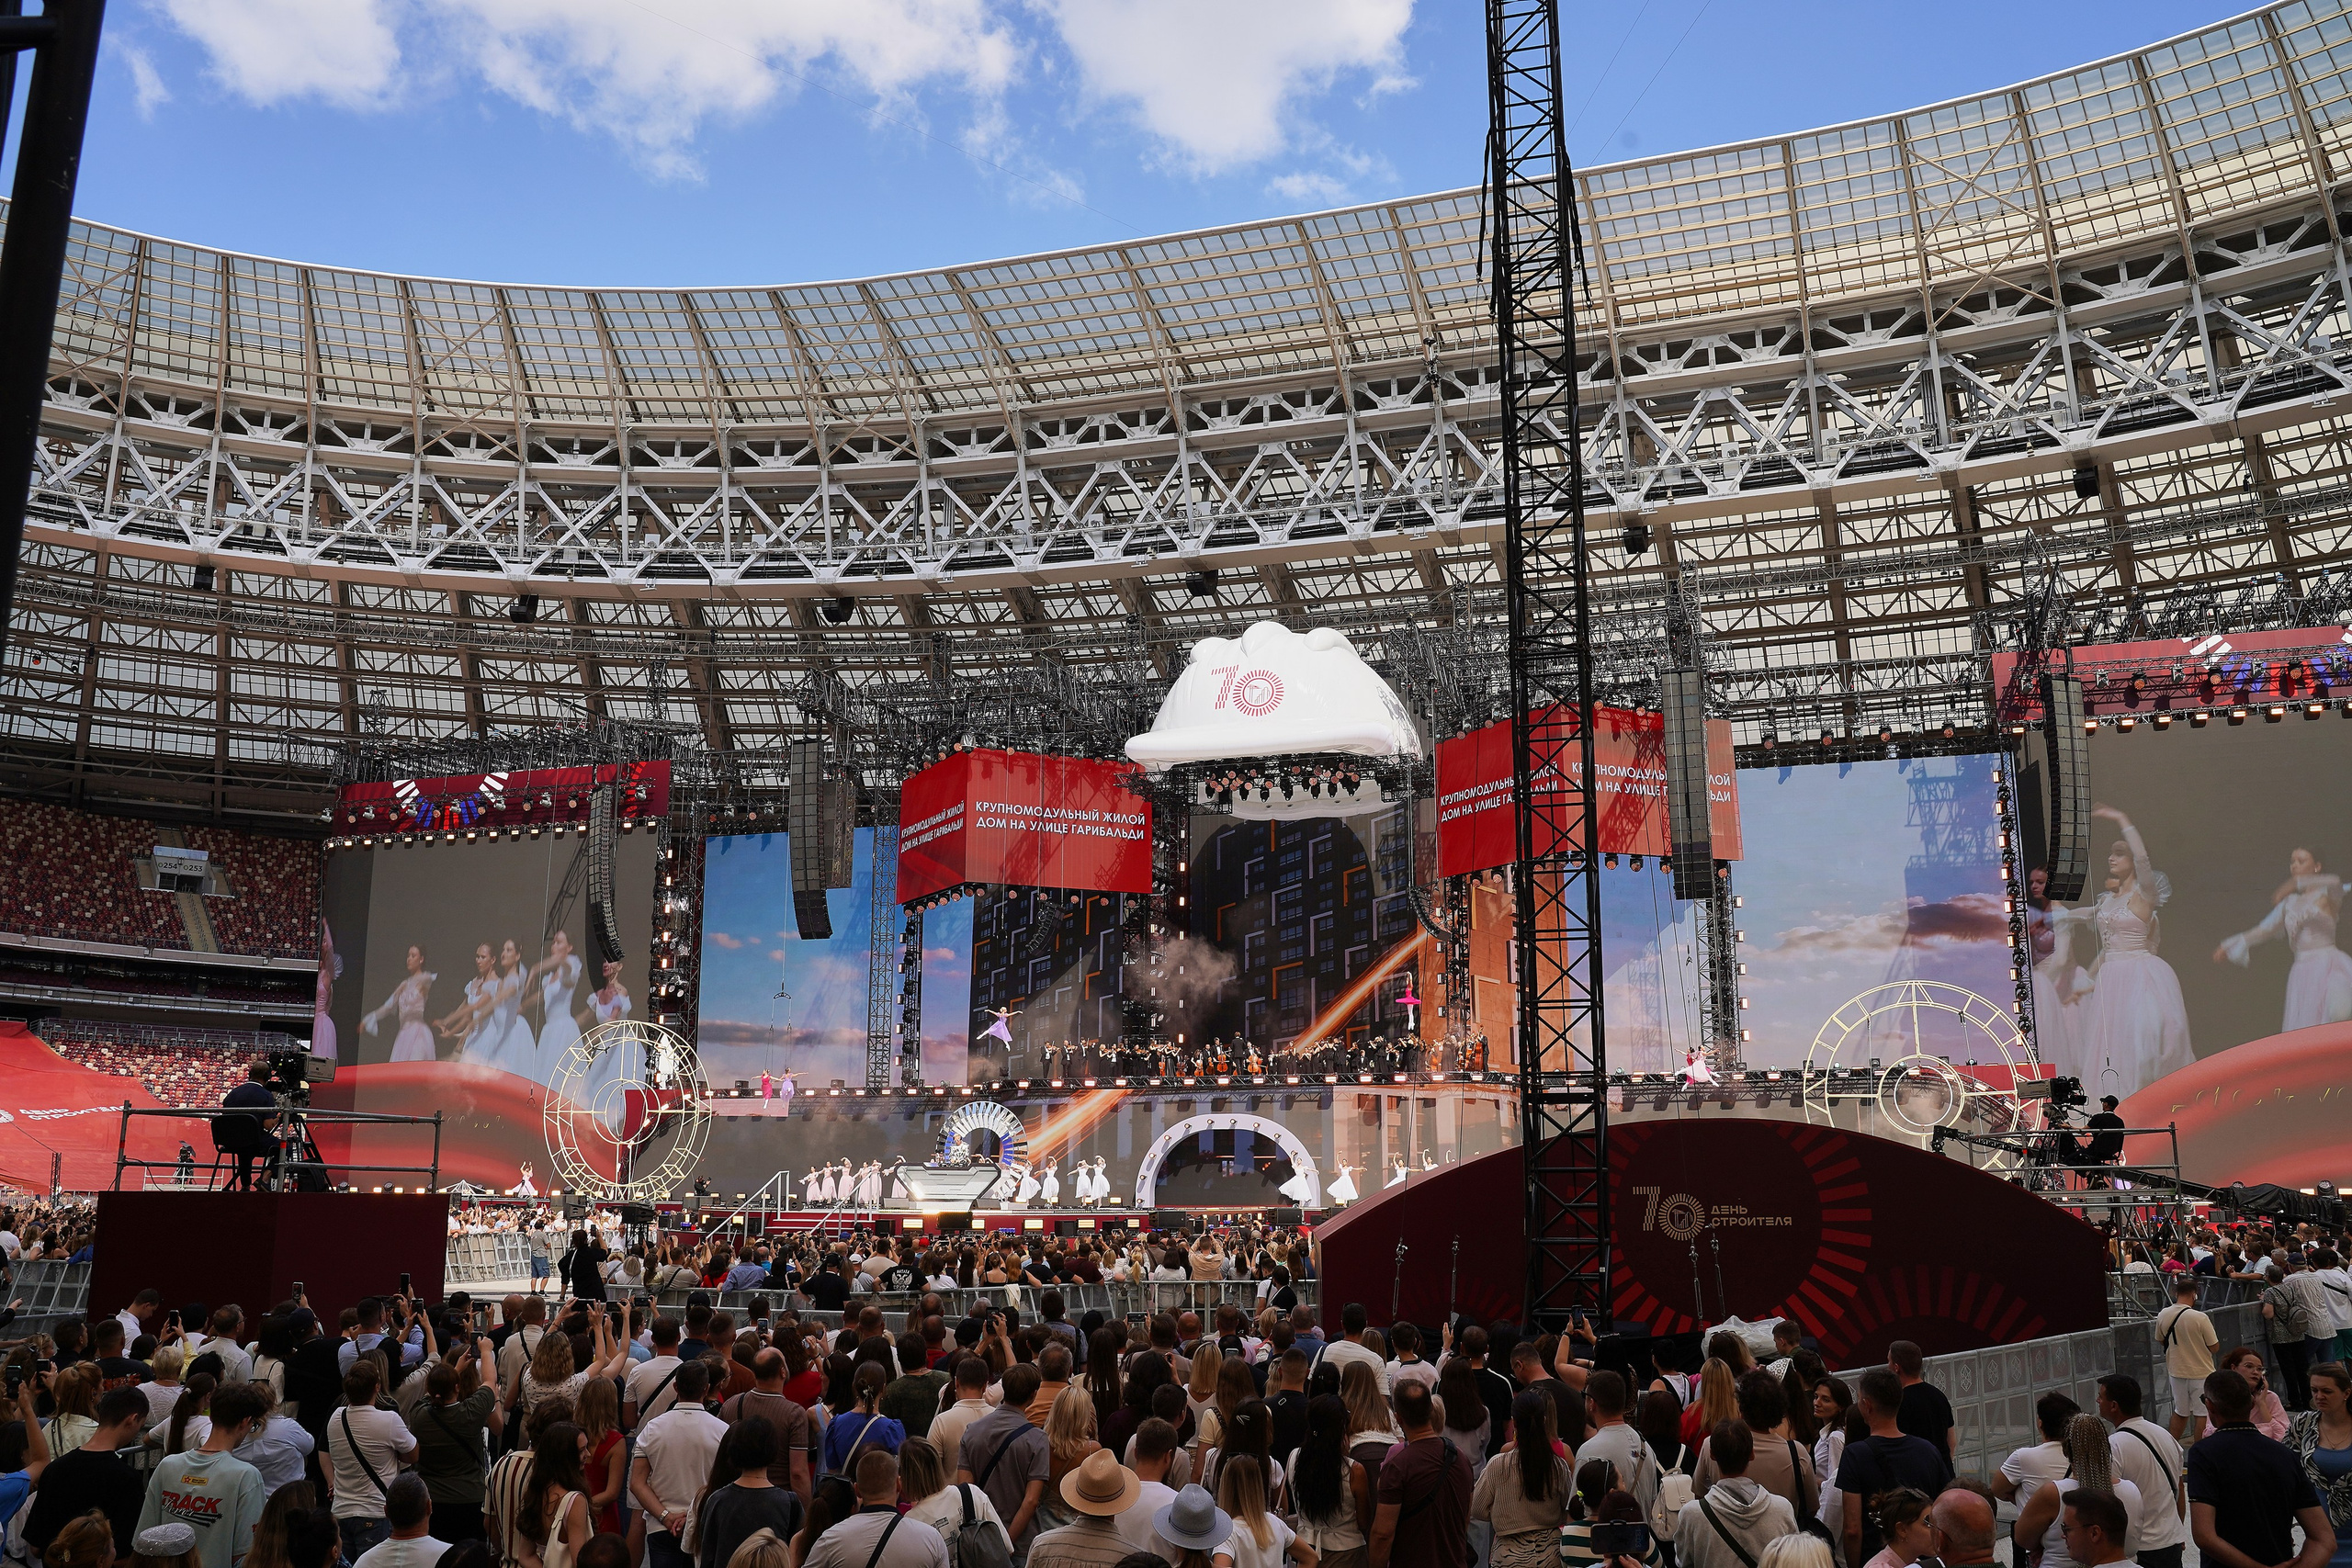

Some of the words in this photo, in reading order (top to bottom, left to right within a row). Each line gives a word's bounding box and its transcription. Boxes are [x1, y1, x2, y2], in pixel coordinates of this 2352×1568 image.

[1574, 778, 1603, 792] ДМ
[1606, 782, 1622, 793] НА
[1624, 784, 1661, 797] УЛИЦЕ
[1708, 773, 1731, 786] ЛОЙ
[946, 800, 965, 819] ЖИЛОЙ
[976, 801, 1100, 822] КРУПНОМОДУЛЬНЫЙ
[1102, 812, 1146, 826] ЖИЛОЙ
[1441, 807, 1461, 823] ДОМ
[1462, 802, 1474, 815] НА
[1475, 795, 1501, 812] УЛИЦЕ
[900, 840, 912, 854] ДОМ
[912, 837, 919, 848] НА
[933, 817, 964, 840] ГАРИБАЛЬДИ
[976, 817, 1006, 829] ДОМ
[1010, 818, 1027, 830] НА
[1030, 820, 1069, 834] УЛИЦЕ
[1071, 824, 1145, 840] ГАРИБАЛЬДИ
[1633, 1186, 1705, 1241] 70
[1711, 1205, 1748, 1214] ДЕНЬ
[1711, 1216, 1792, 1227] СТРОИТЕЛЯ
[161, 1490, 223, 1514] TRACK
